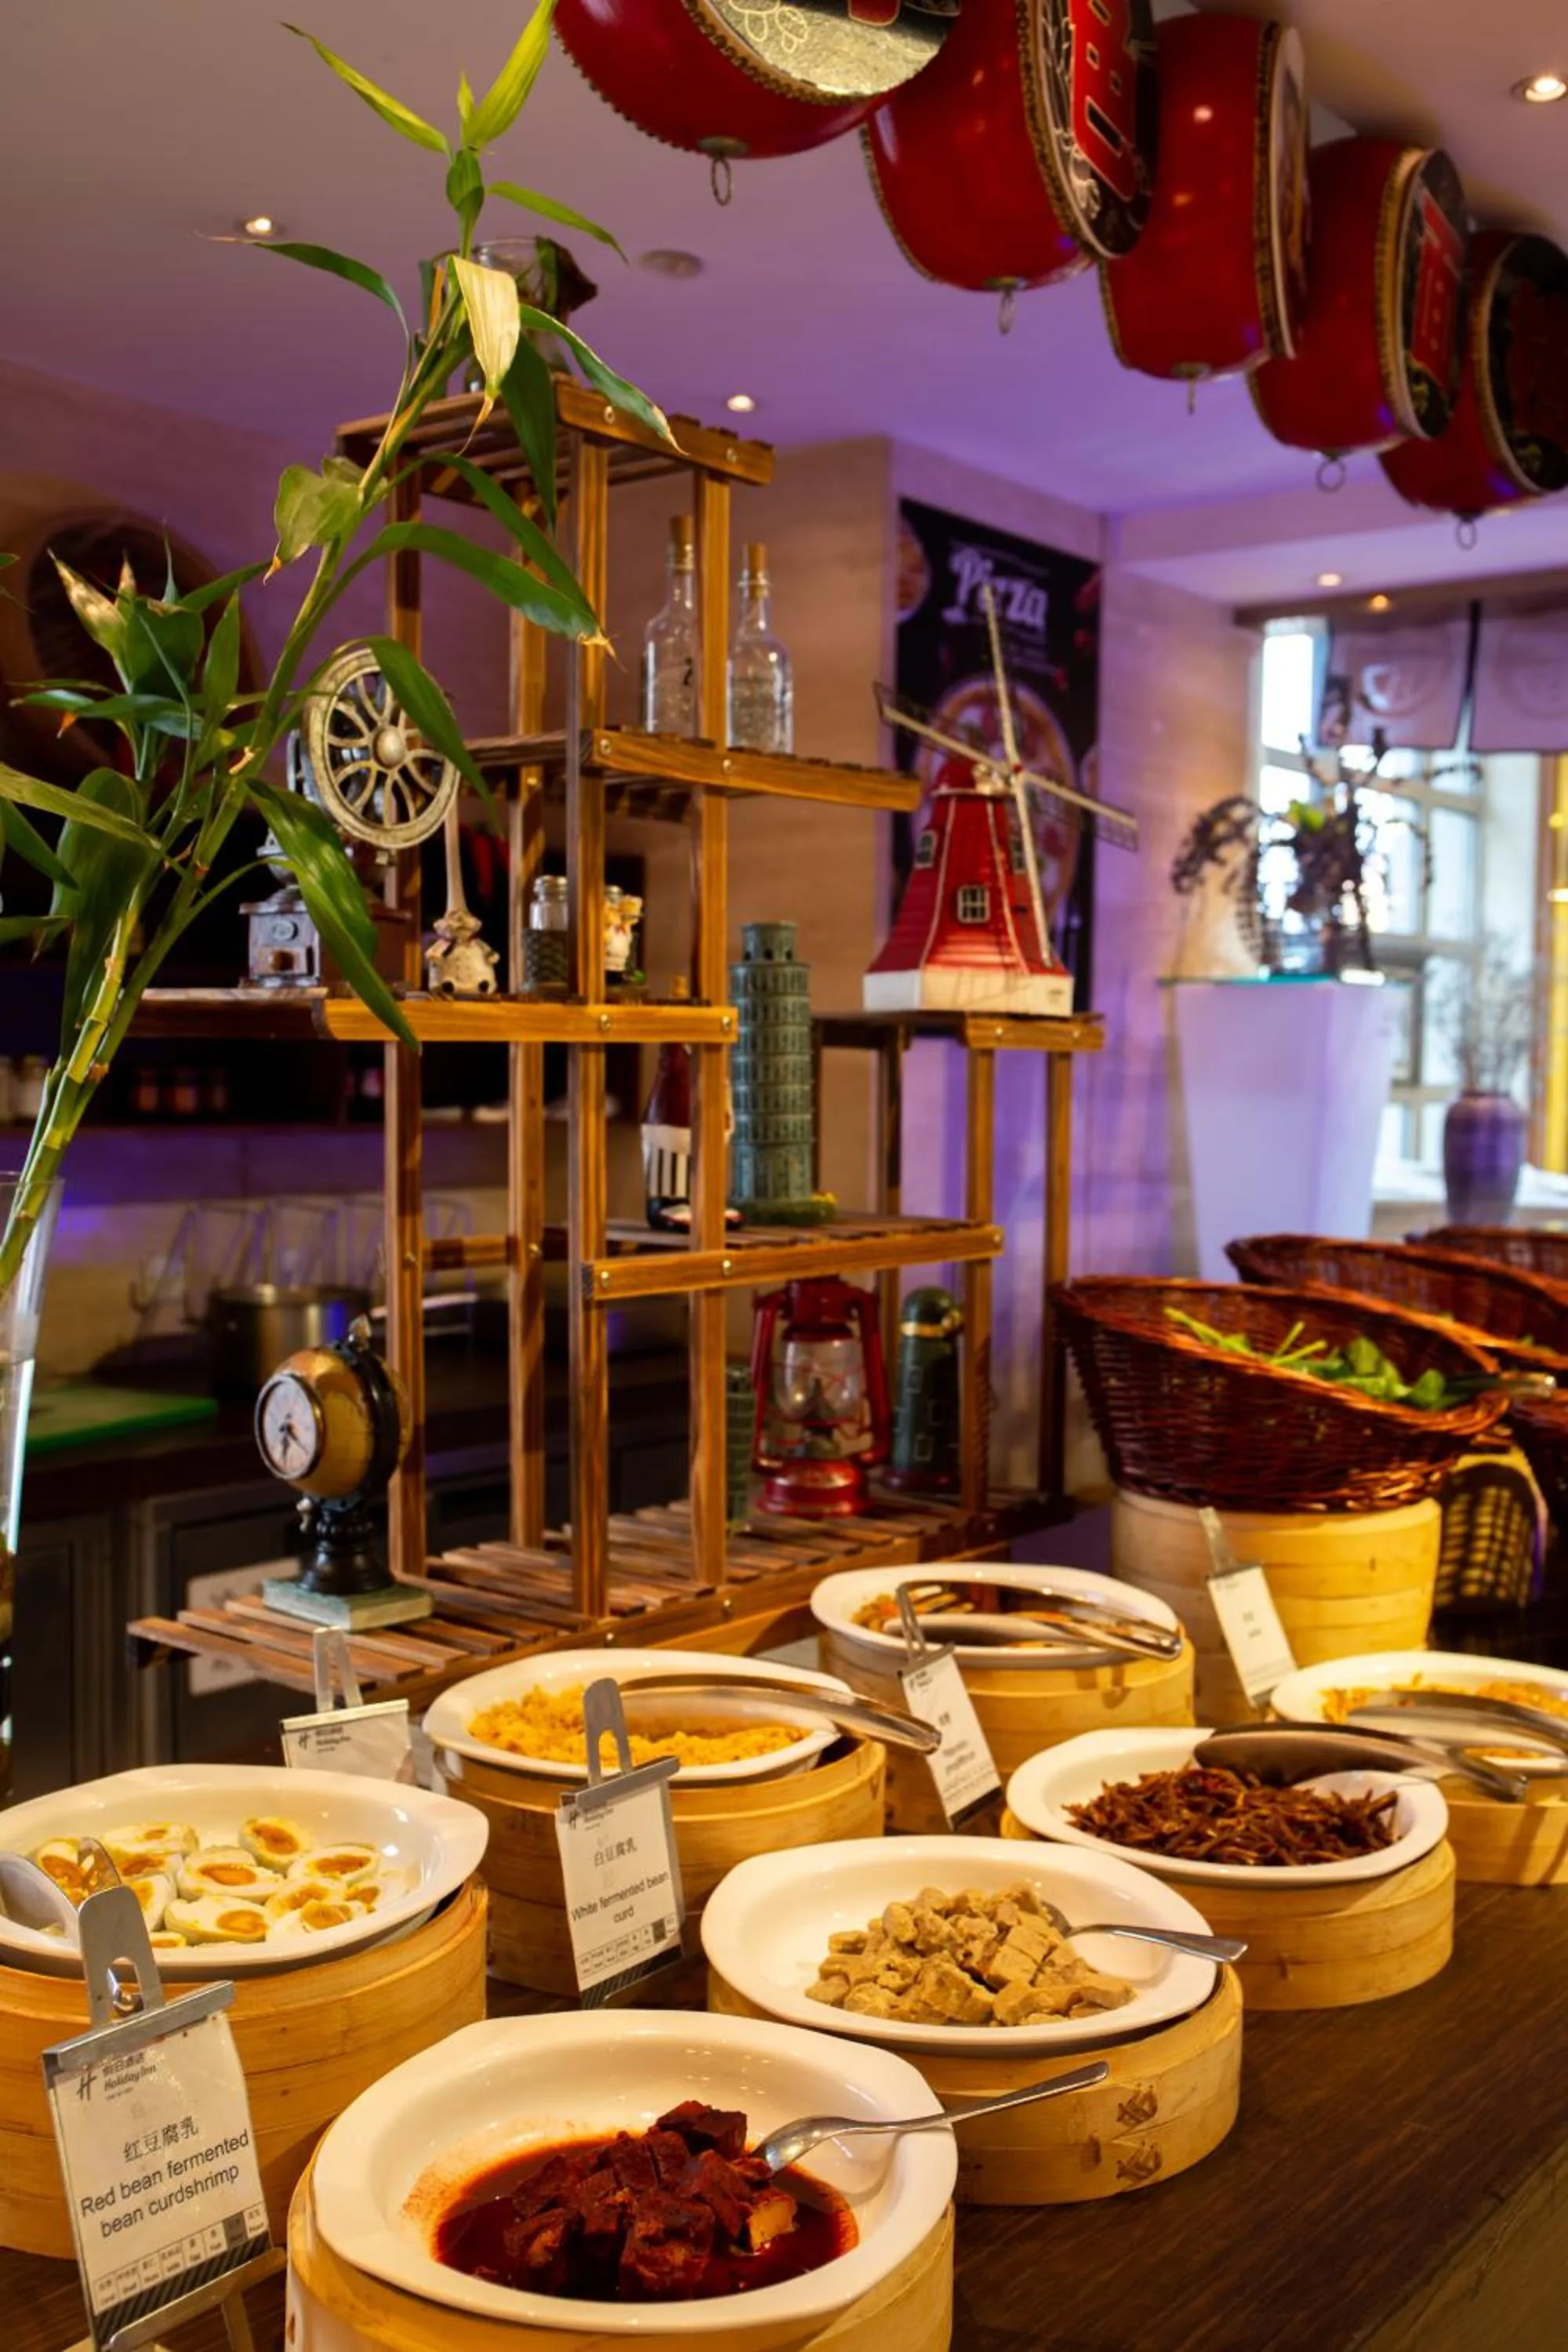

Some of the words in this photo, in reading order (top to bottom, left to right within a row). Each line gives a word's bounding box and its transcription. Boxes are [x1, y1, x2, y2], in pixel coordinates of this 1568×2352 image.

[942, 547, 1047, 632] Pizza
[572, 1901, 598, 1922] White
[600, 1879, 645, 1908] fermented
[646, 1871, 668, 1889] bean
[613, 1904, 634, 1923] curd
[104, 2073, 140, 2092] Holiday
[141, 2064, 157, 2077] Inn
[123, 2116, 198, 2160] 红豆腐乳
[80, 2187, 115, 2217] Red
[120, 2170, 163, 2199] bean
[166, 2129, 249, 2179] fermented
[100, 2208, 143, 2238] bean
[148, 2165, 239, 2216] curdshrimp
